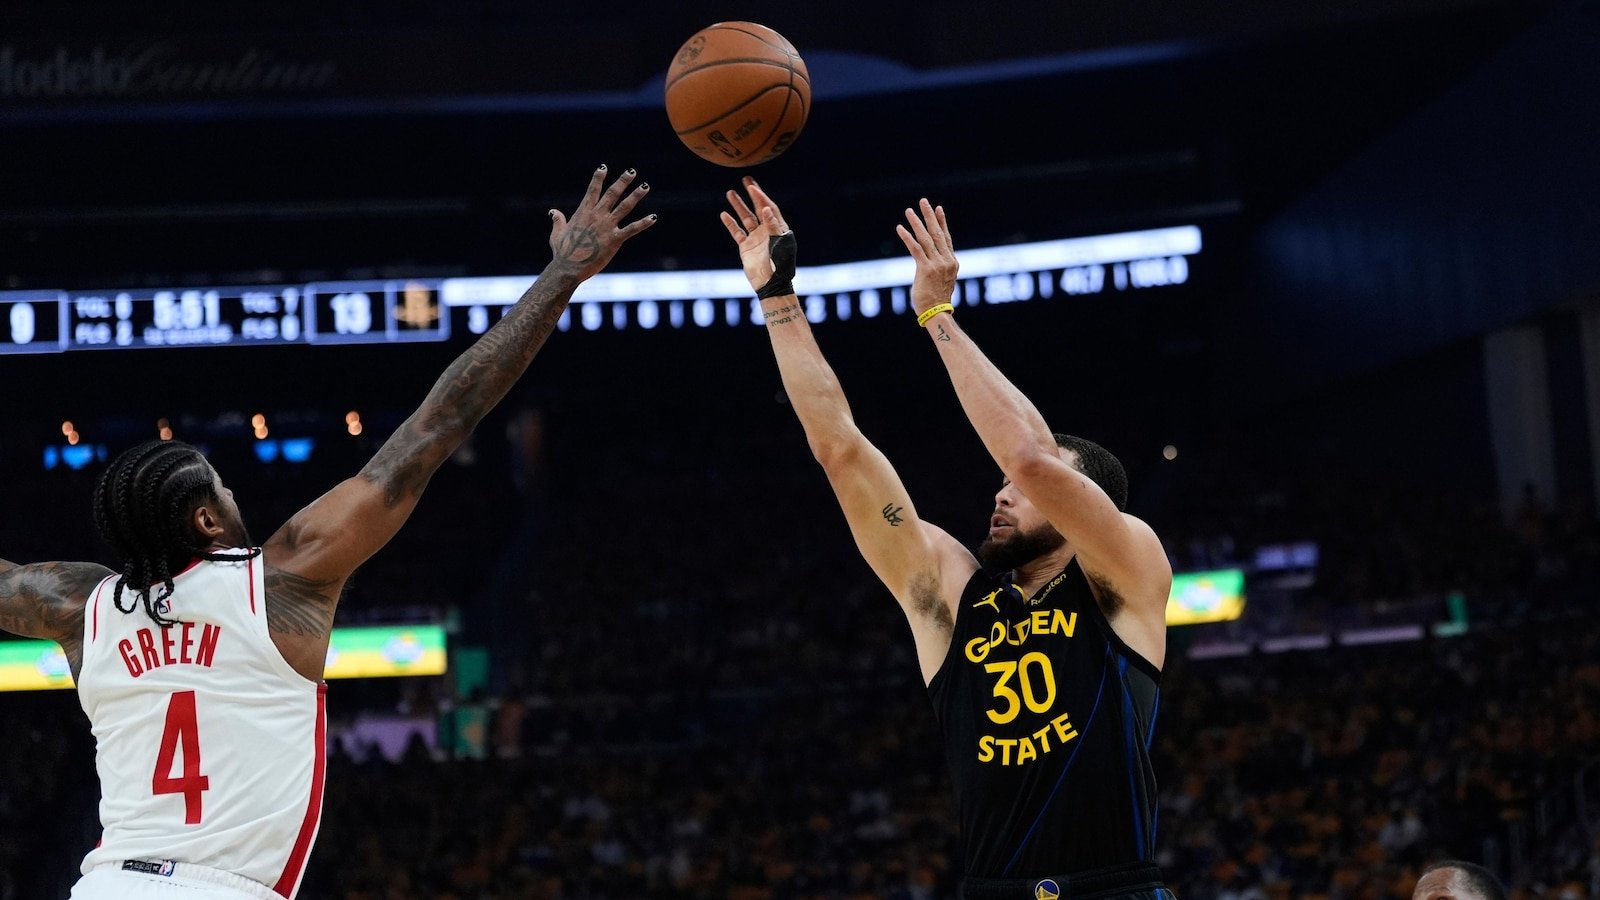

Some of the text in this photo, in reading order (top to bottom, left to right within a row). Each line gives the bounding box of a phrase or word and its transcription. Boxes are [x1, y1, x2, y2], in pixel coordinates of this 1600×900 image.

[1030, 573, 1067, 606] Ruten
[118, 622, 221, 678] GREEN
[965, 609, 1077, 663] GOLDEN
[984, 652, 1056, 725] 30
[152, 690, 209, 824] 4
[978, 713, 1078, 766] STATE
